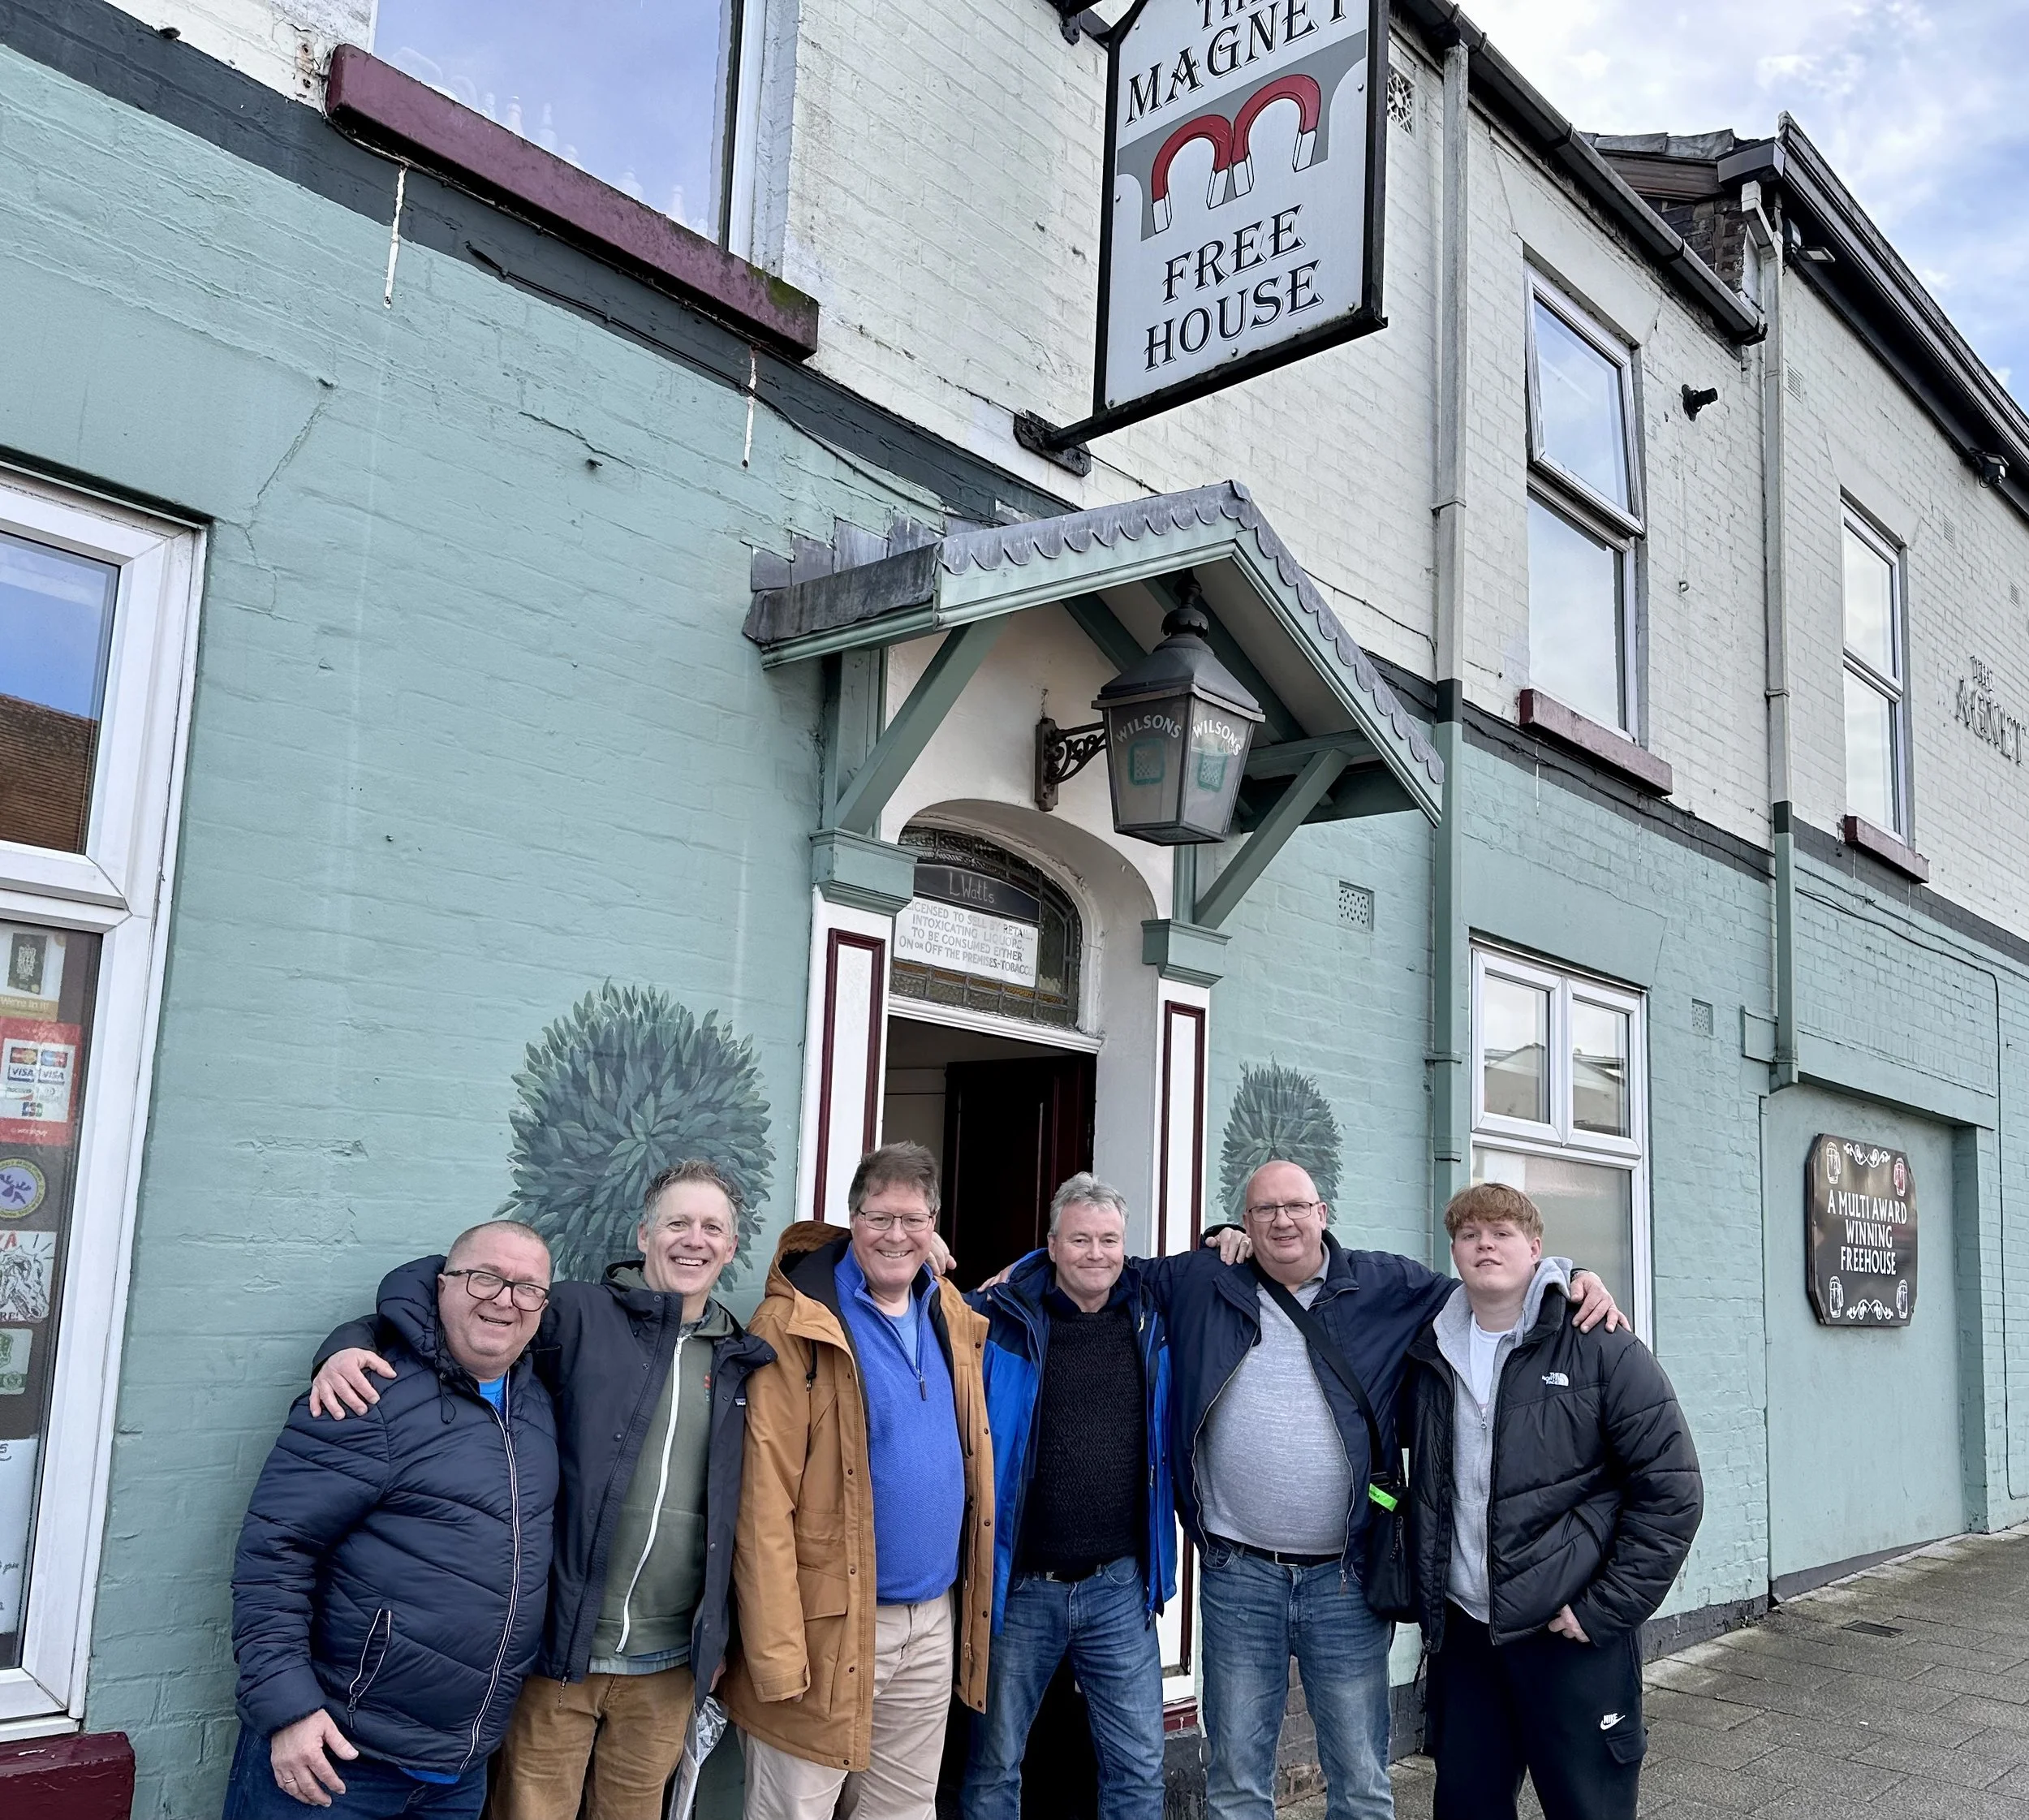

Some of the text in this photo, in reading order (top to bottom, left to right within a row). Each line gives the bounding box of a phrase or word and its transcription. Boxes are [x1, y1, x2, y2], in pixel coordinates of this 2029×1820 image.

[1162, 205, 1306, 305] FREE
[1144, 259, 1324, 372] HOUSE
[1970, 655, 1994, 692] THE
[1115, 714, 1182, 743] WILSONS
[1193, 720, 1242, 756] WILSONS
[949, 871, 959, 896] L
[912, 914, 978, 939] INTOXICATING
[953, 911, 964, 923] TO
[967, 915, 987, 929] SELL
[990, 921, 1001, 931] BY
[898, 935, 913, 950] ON
[925, 941, 943, 955] OFF
[945, 947, 960, 960] THE
[911, 926, 1023, 962] TO BE CONSUMED EITHER
[12, 1067, 64, 1080] VISA VISA
[1827, 1189, 1907, 1225] A MULTI AWARD
[1845, 1219, 1893, 1249] WINNING
[1840, 1246, 1897, 1275] FREEHOUSE
[1604, 1713, 1618, 1724] NIKE
